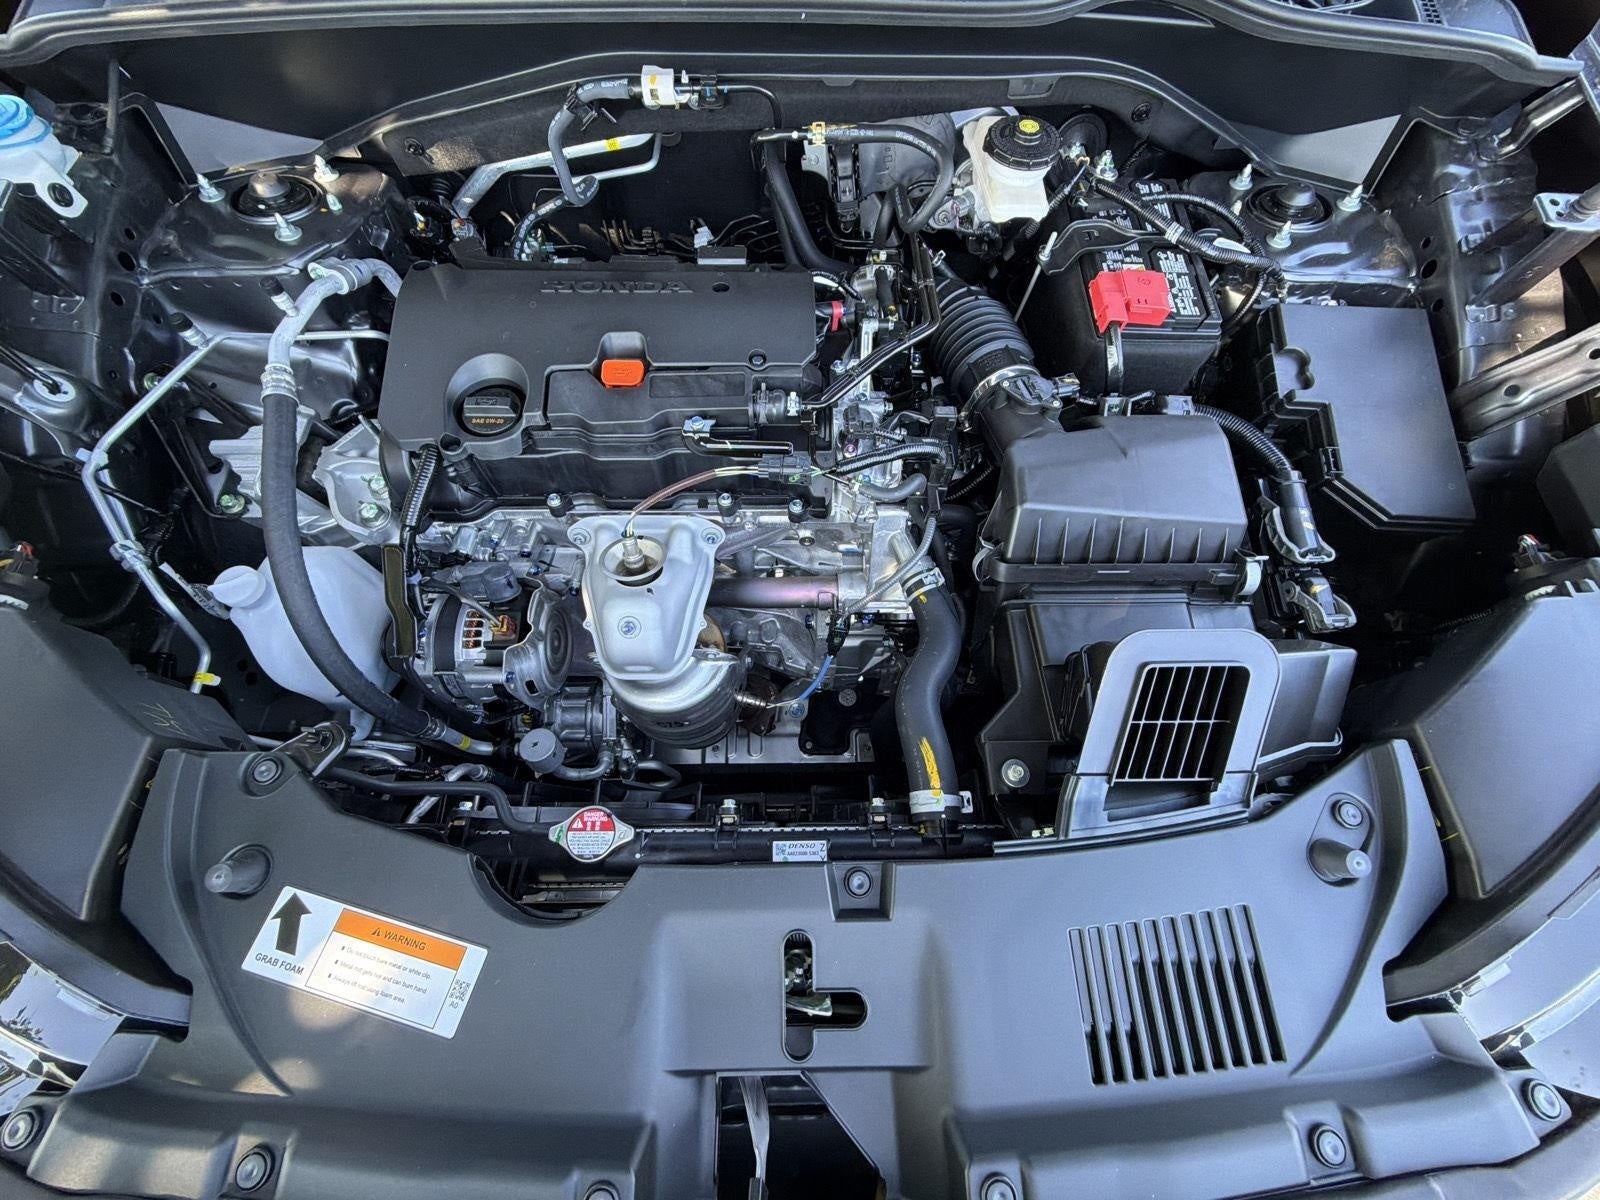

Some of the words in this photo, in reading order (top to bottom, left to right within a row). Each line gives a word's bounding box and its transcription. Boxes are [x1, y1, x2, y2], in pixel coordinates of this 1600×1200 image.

[540, 280, 694, 294] HONDA
[384, 930, 427, 951] WARNING
[255, 953, 280, 967] GRAB
[279, 960, 304, 975] FOAM
